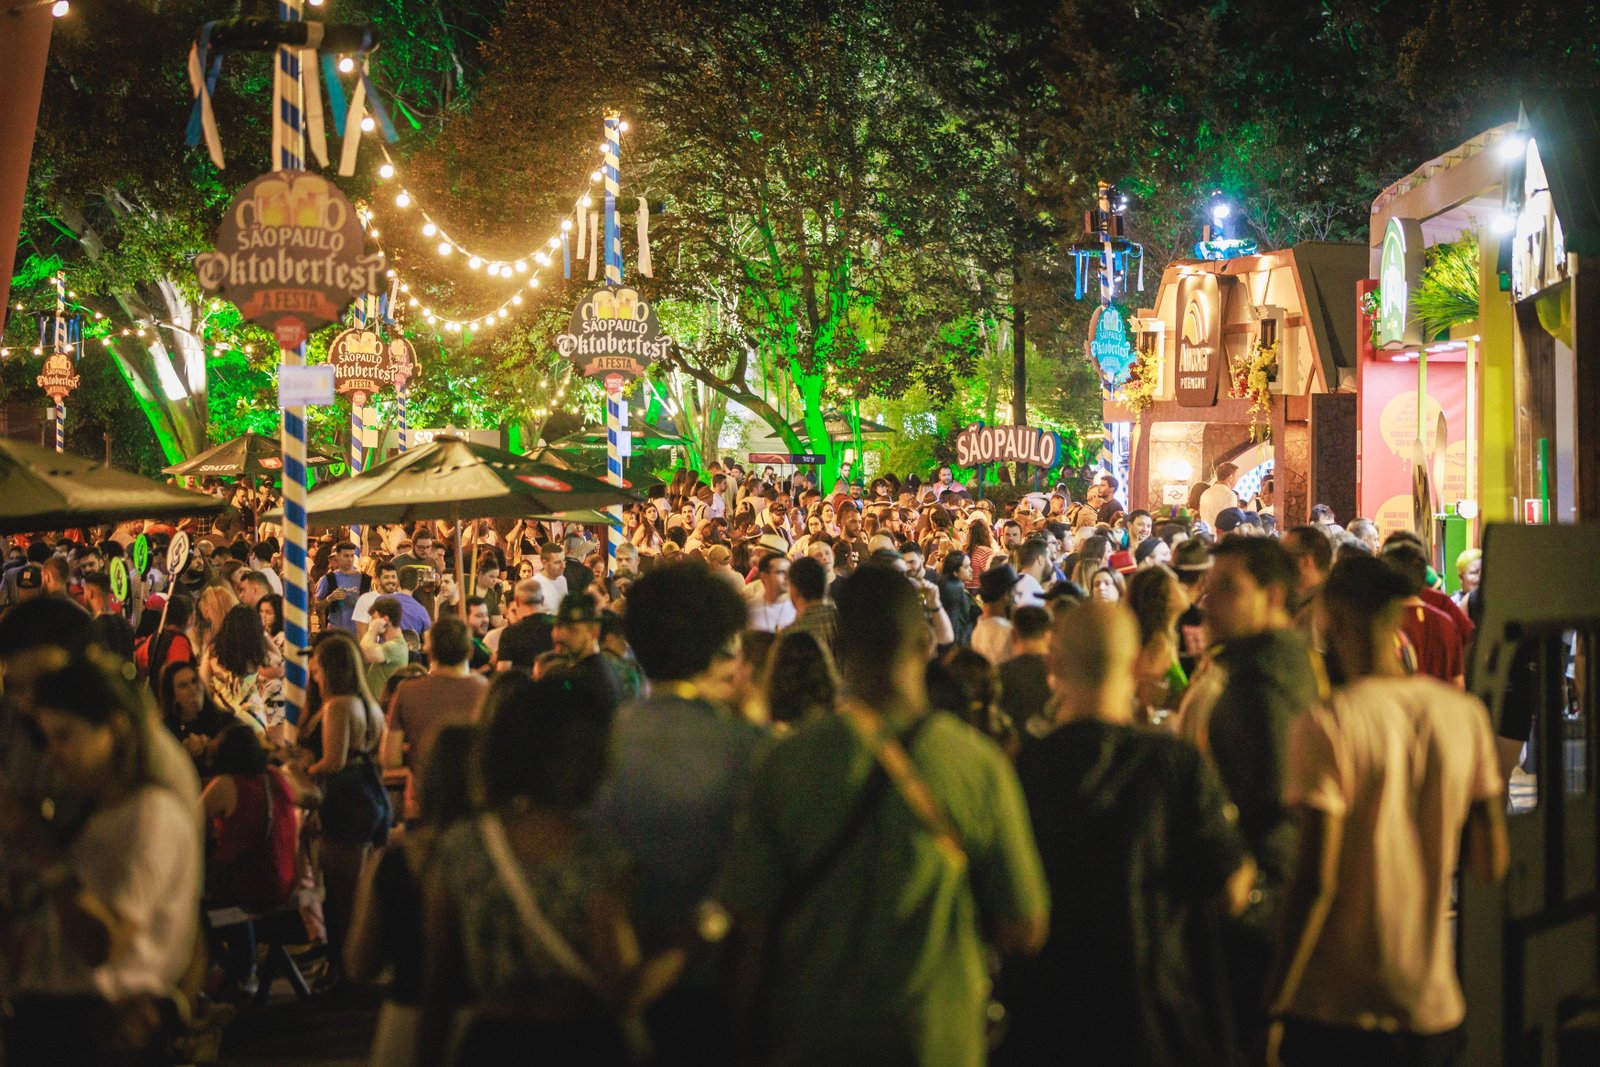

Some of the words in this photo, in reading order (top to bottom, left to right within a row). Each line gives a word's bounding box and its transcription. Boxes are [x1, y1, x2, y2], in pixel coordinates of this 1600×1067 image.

[195, 249, 386, 297] Oktoberfest
[262, 292, 271, 309] A
[275, 291, 318, 310] FESTA
[556, 332, 673, 361] Oktoberfest
[322, 361, 398, 383] ktoberfest
[598, 360, 604, 369] A
[606, 358, 632, 369] FESTA
[354, 380, 372, 389] FESTA
[199, 463, 239, 472] SPATEN
